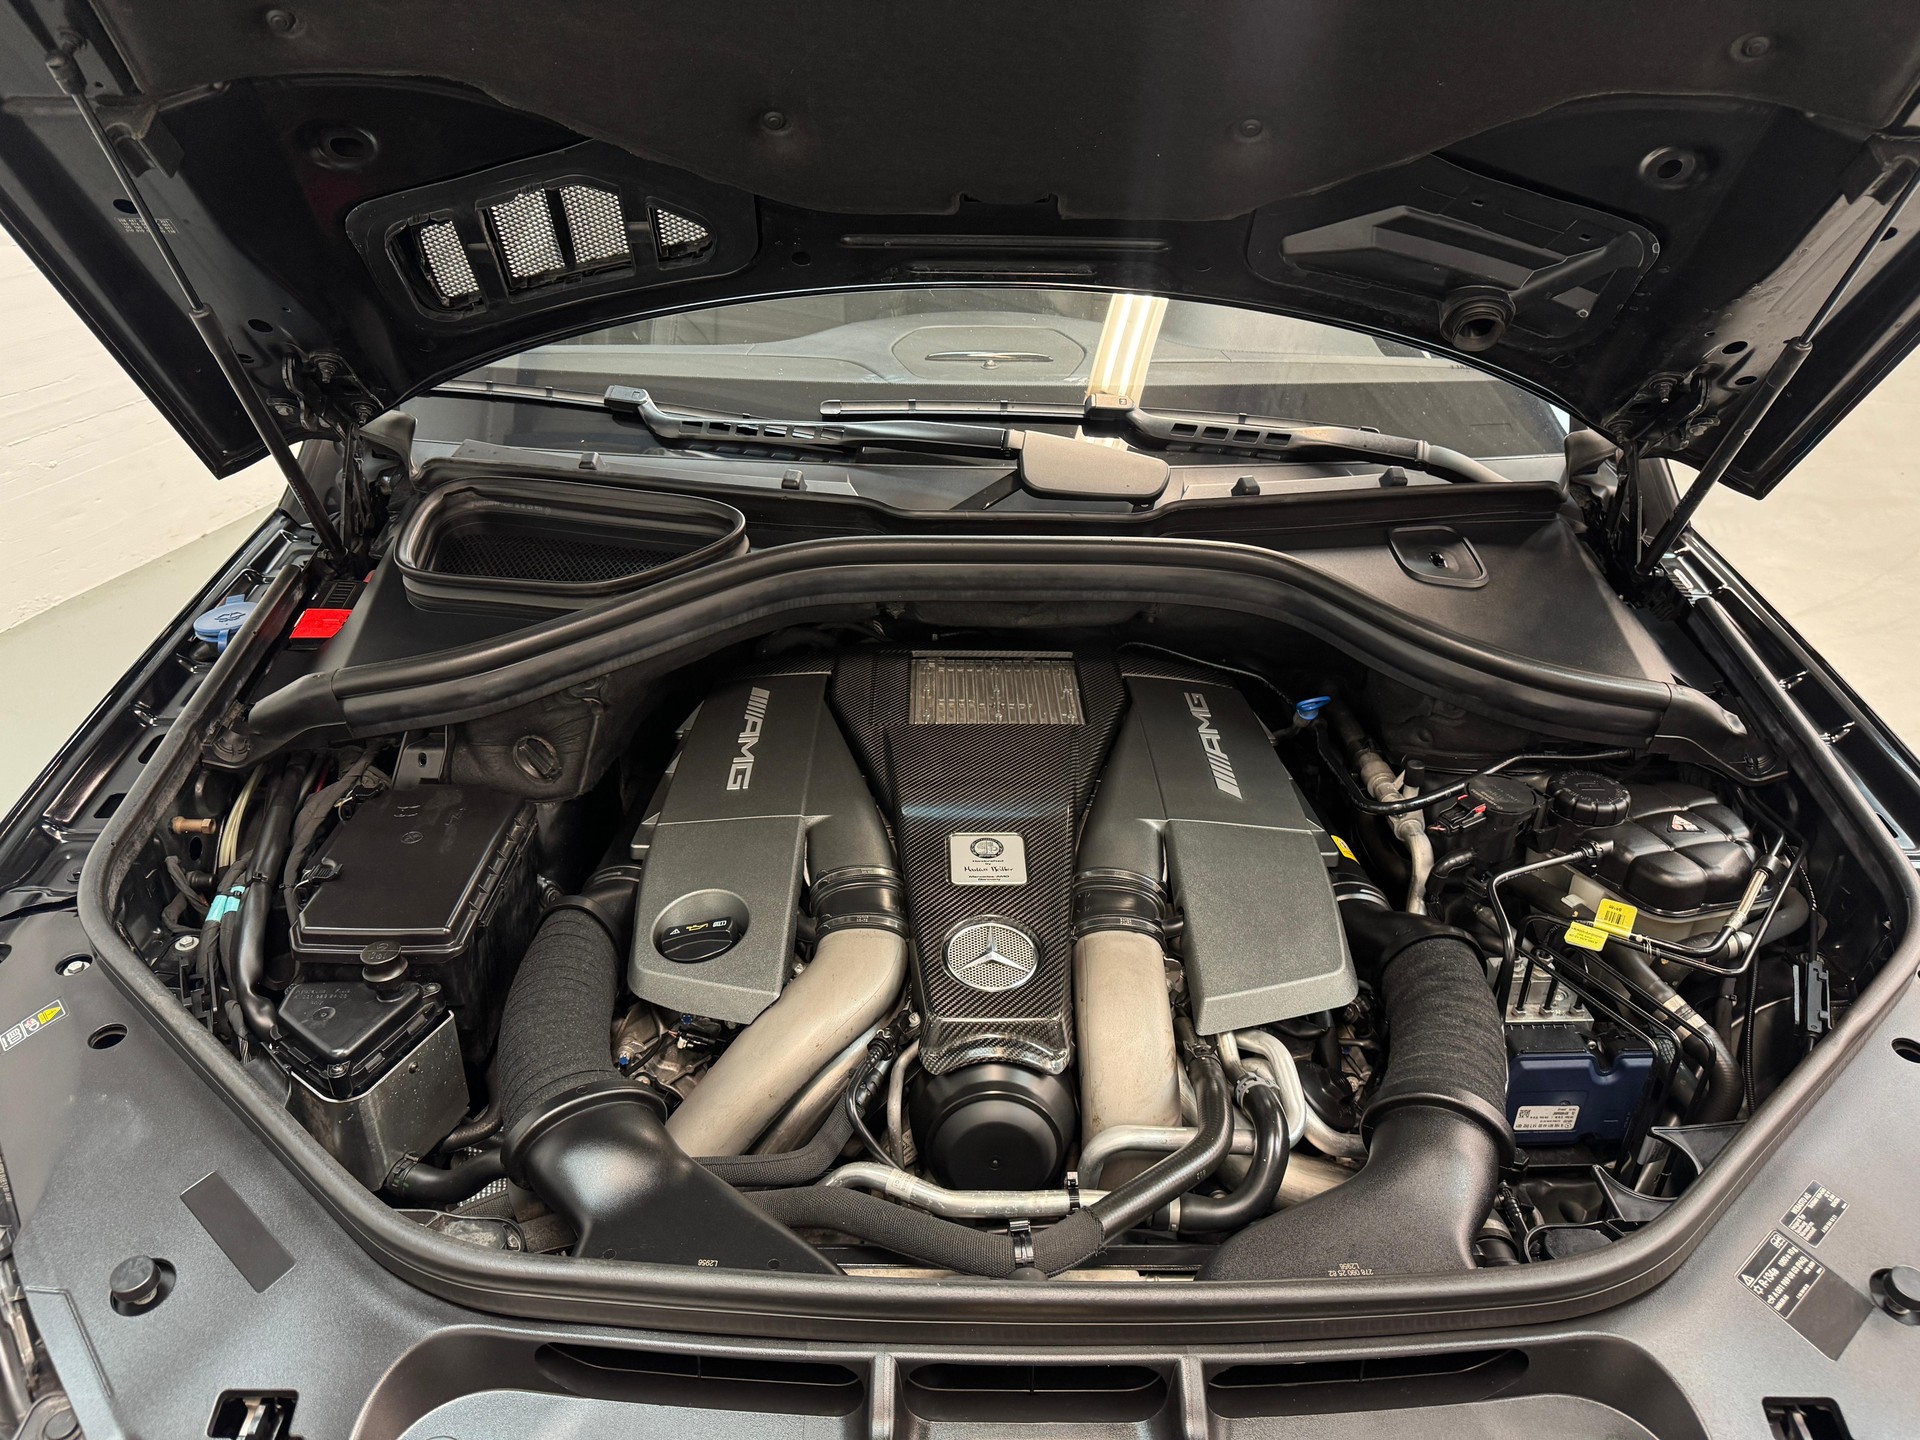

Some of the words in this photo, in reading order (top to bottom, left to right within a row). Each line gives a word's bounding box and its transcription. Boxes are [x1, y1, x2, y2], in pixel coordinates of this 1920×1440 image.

[726, 713, 765, 791] AMG
[1184, 692, 1231, 766] AMG
[1758, 1267, 1780, 1288] R-134a
